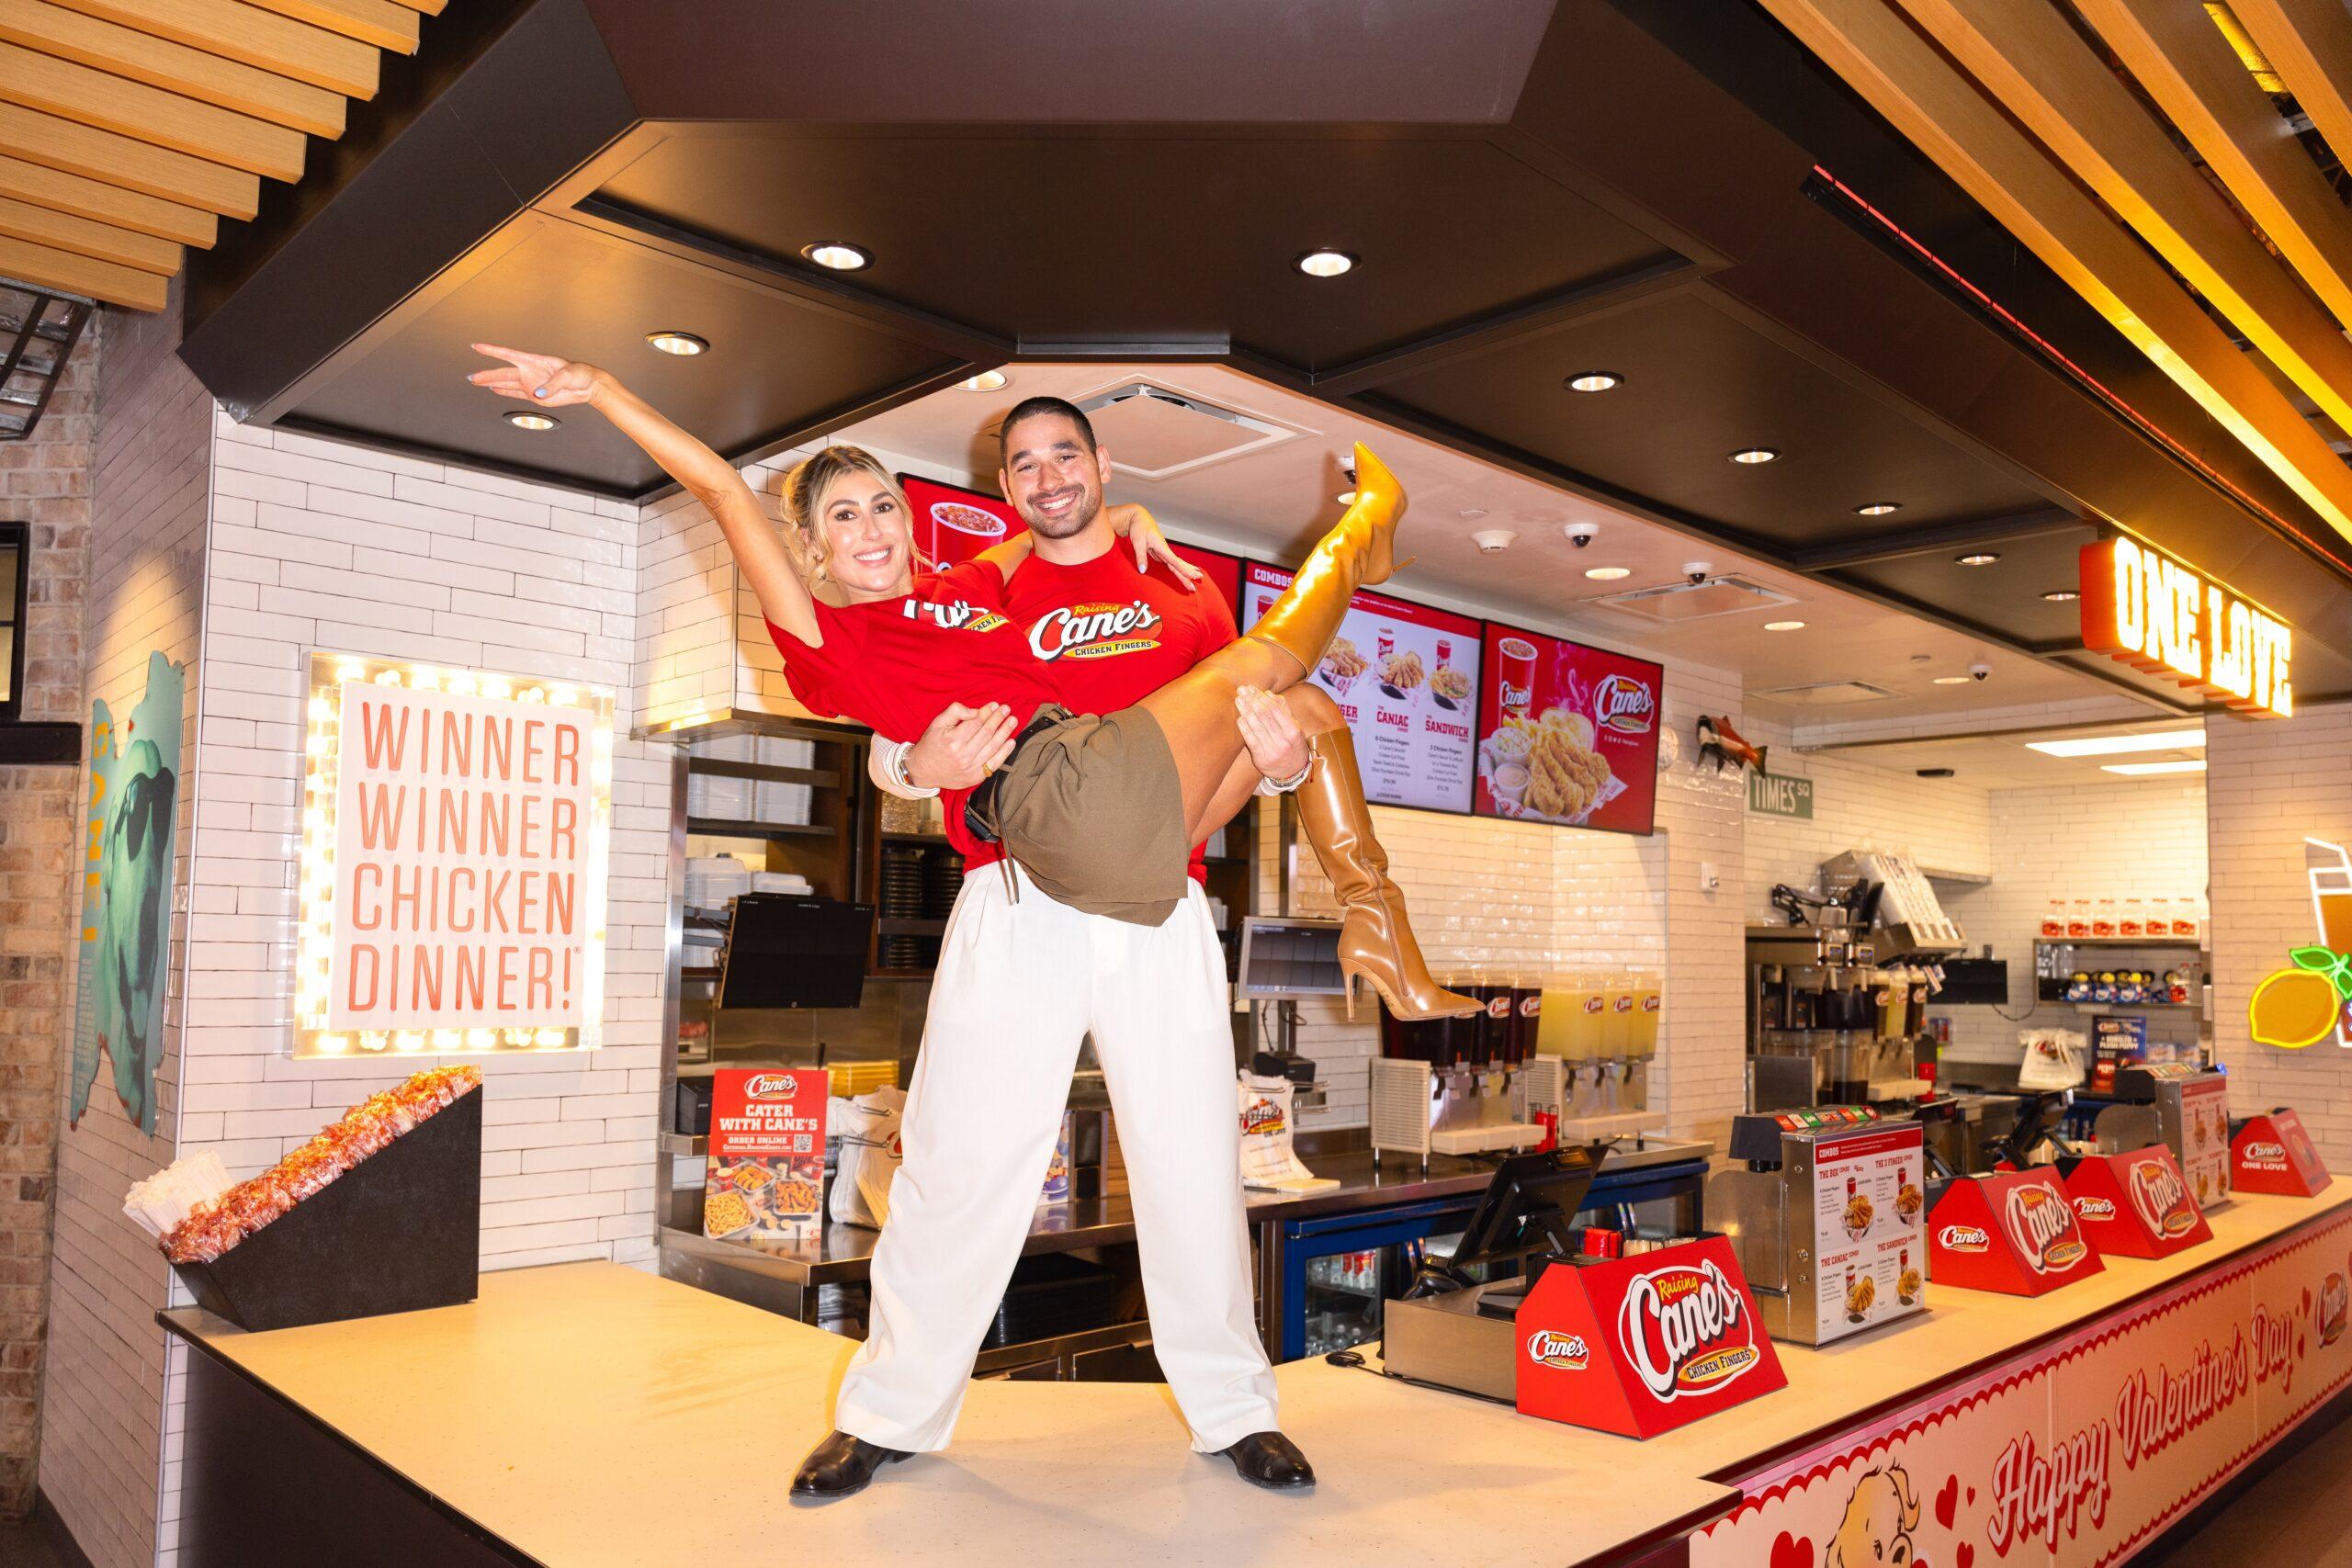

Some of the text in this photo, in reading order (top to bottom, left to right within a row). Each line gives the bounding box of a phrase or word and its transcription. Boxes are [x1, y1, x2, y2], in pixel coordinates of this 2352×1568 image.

[1074, 604, 1121, 615] Raising
[1028, 600, 1161, 660] Cane's
[2114, 536, 2292, 717] ONE LOVE
[1075, 642, 1152, 656] CHICKEN FINGERS
[1338, 704, 1358, 718] GER
[1597, 674, 1654, 724] Cane's
[1376, 711, 1409, 728] CANIAC
[1425, 720, 1469, 738] SANDWICH
[362, 702, 581, 786] WINNER
[1753, 774, 1810, 814] TIMES SQ
[358, 781, 577, 860] WINNER
[352, 863, 574, 935] CHICKEN
[747, 1075, 796, 1098] Cane's
[719, 1118, 818, 1131] WITH CANE'S
[745, 1104, 794, 1117] CATER
[728, 1136, 787, 1145] ORDER ONLINE
[2263, 1163, 2288, 1171] LOVE
[1940, 1225, 1987, 1248] Cane's
[2010, 1181, 2073, 1271] Cane's
[1657, 1274, 1699, 1302] Raising
[1629, 1263, 1742, 1398] Cane's
[1531, 1331, 1589, 1361] Cane's
[1687, 1349, 1751, 1380] CHICKEN FINGERS
[1987, 1303, 2293, 1558] Happy Valentine's Day
